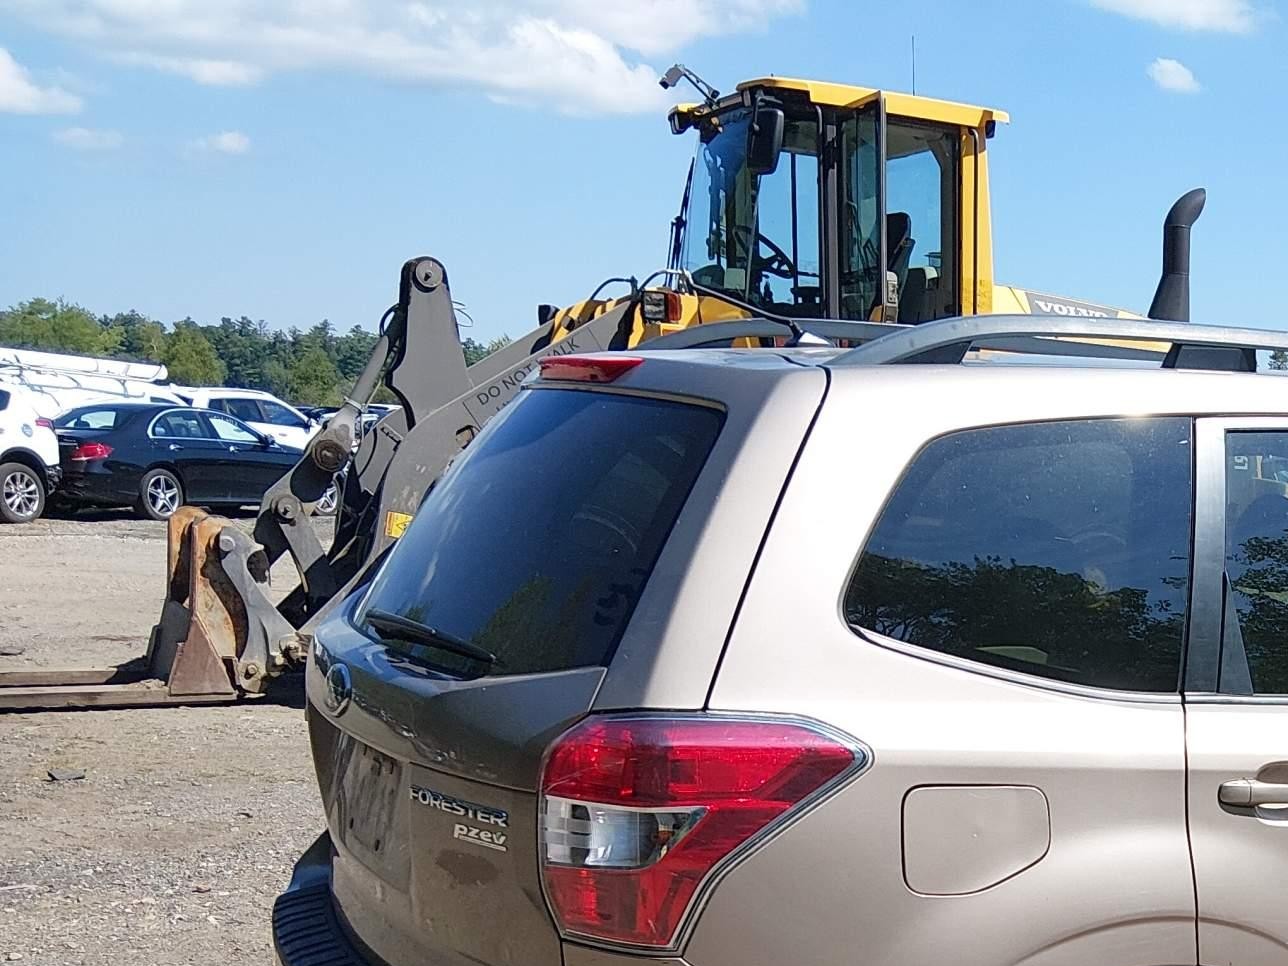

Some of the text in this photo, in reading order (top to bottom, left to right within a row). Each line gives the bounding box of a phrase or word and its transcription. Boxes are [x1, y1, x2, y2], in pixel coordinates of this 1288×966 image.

[477, 385, 501, 405] DO
[502, 363, 532, 390] NOT
[409, 784, 510, 828] FORESTER
